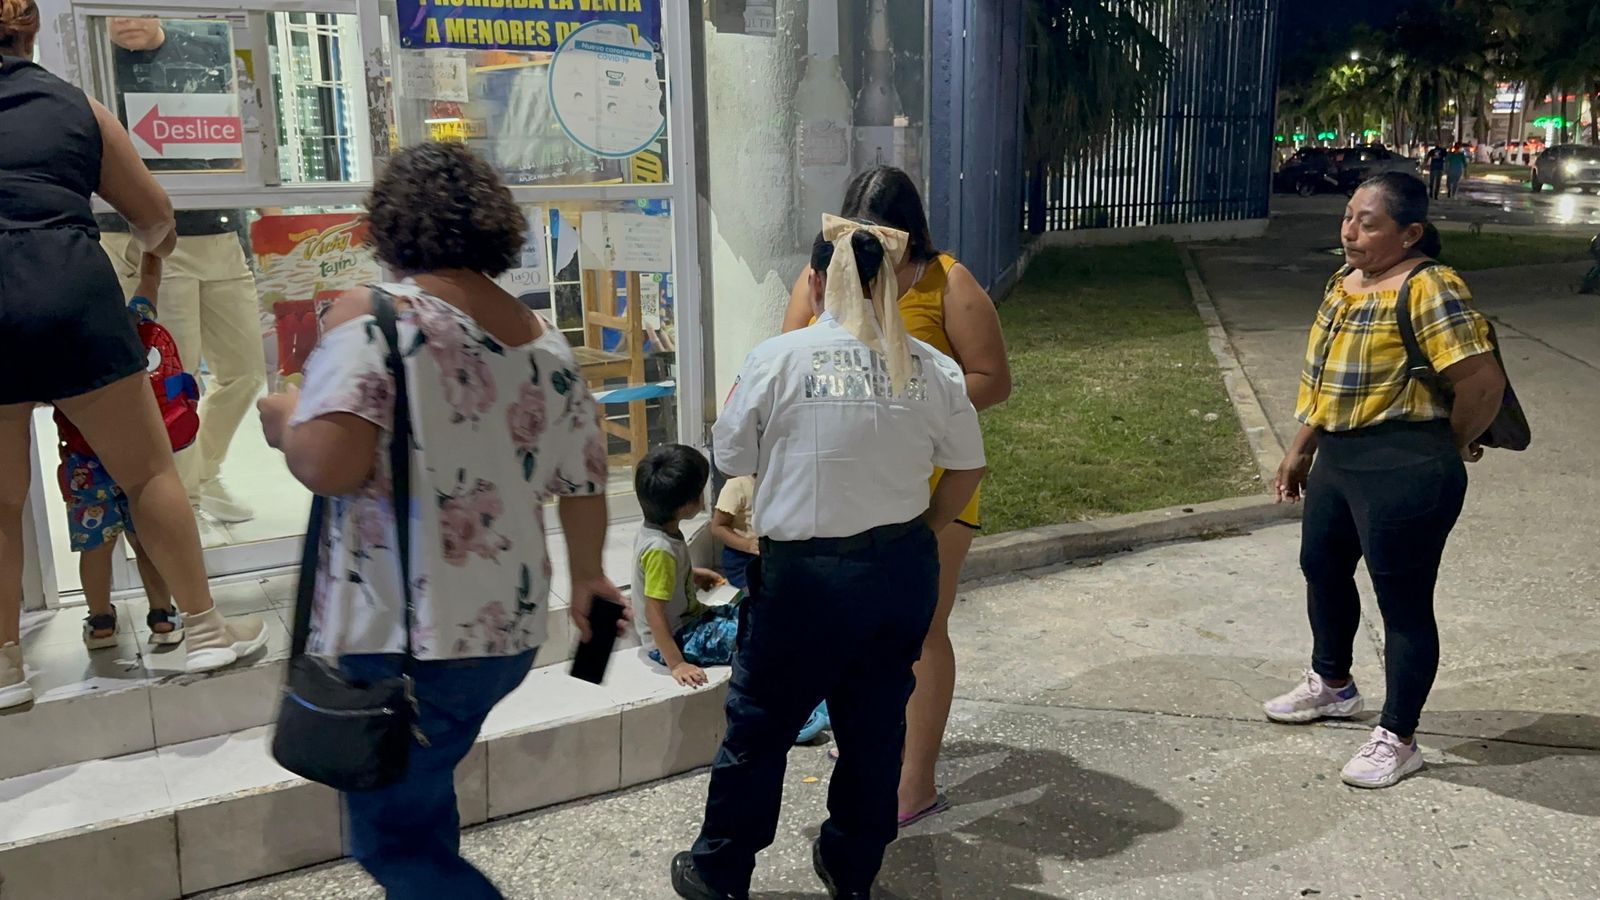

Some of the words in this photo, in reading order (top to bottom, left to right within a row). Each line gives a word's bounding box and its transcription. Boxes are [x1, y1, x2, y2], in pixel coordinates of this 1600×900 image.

[425, 17, 441, 43] A
[444, 17, 551, 47] MENORES
[581, 42, 604, 52] Nuevo
[605, 45, 646, 58] coronavirus
[152, 119, 235, 140] Deslice
